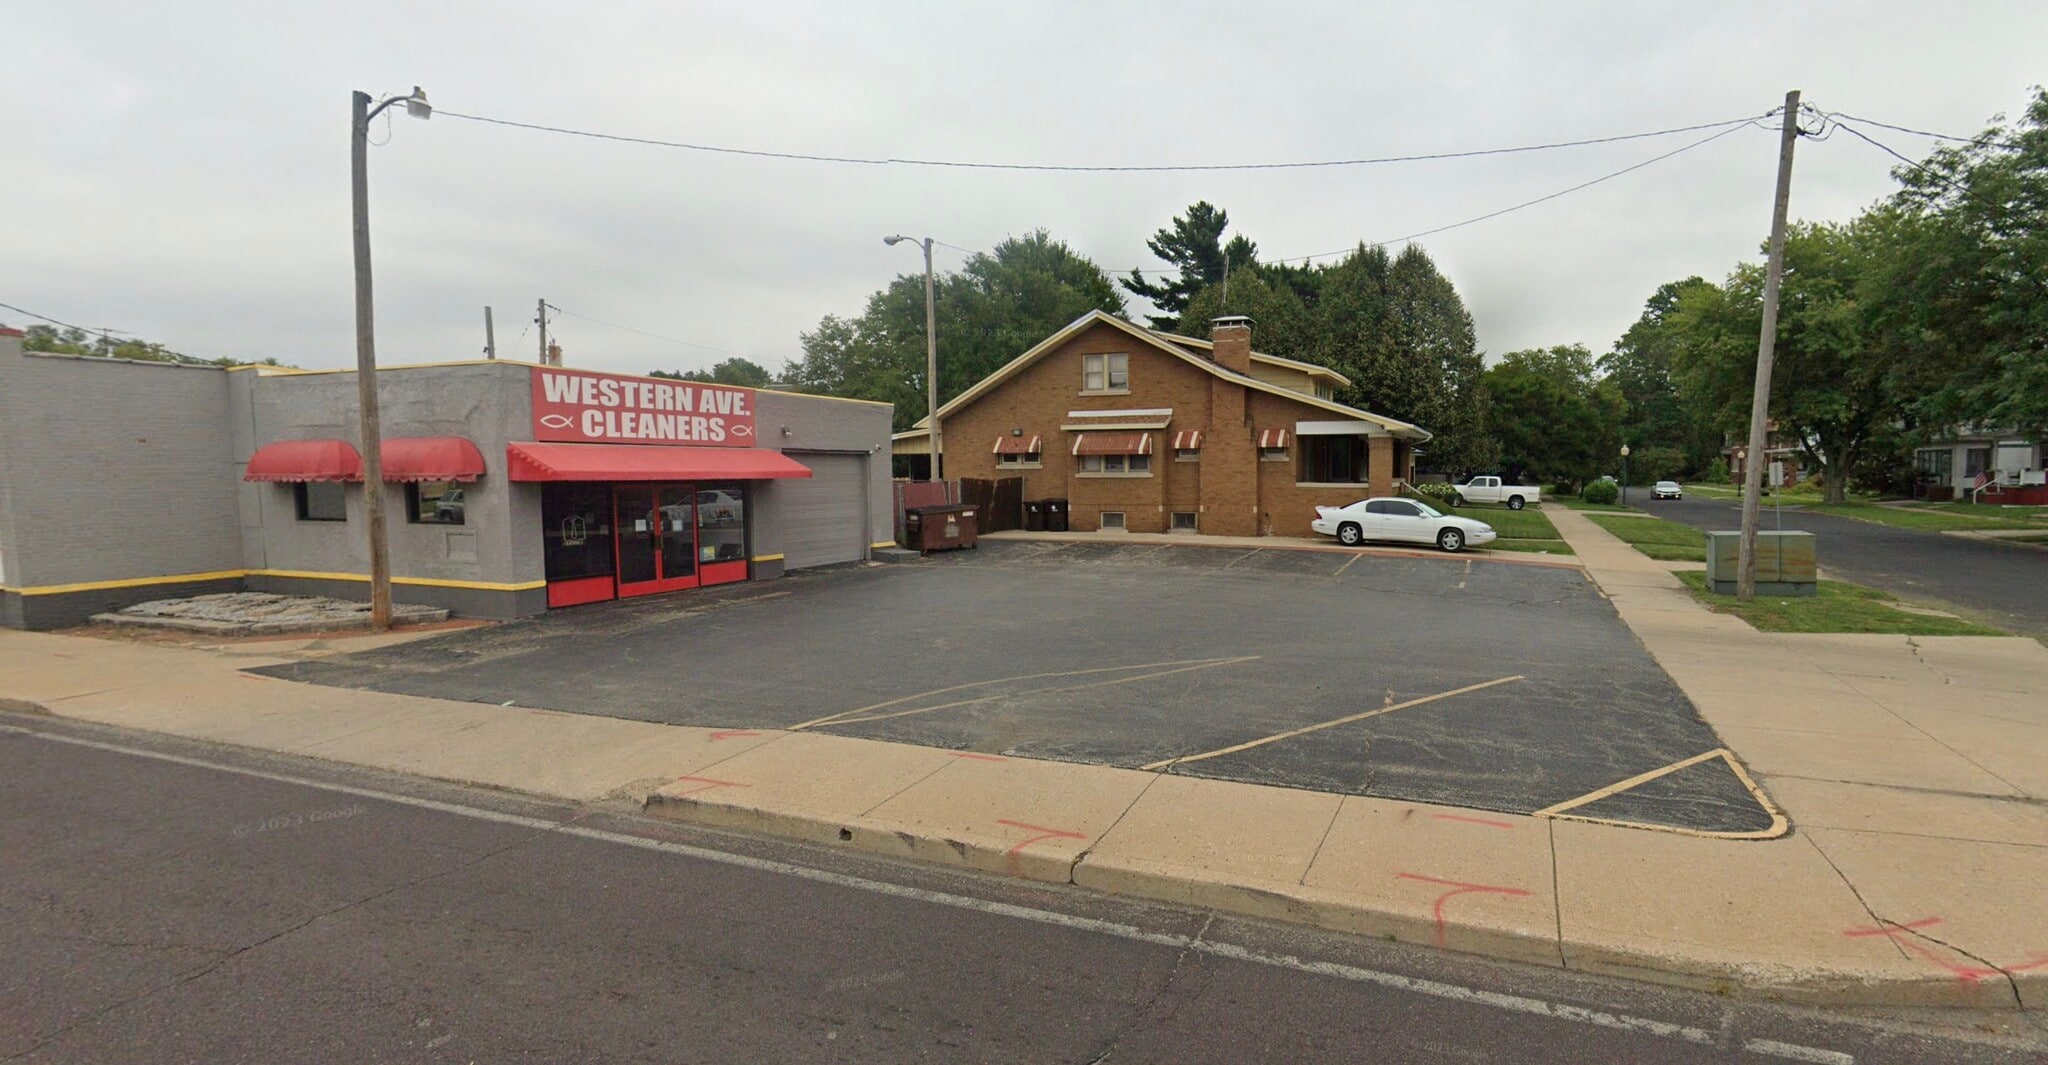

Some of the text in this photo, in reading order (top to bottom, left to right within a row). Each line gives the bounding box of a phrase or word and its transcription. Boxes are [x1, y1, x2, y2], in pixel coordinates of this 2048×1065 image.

[542, 373, 750, 416] WESTERN AVE.
[581, 409, 726, 442] CLEANERS
